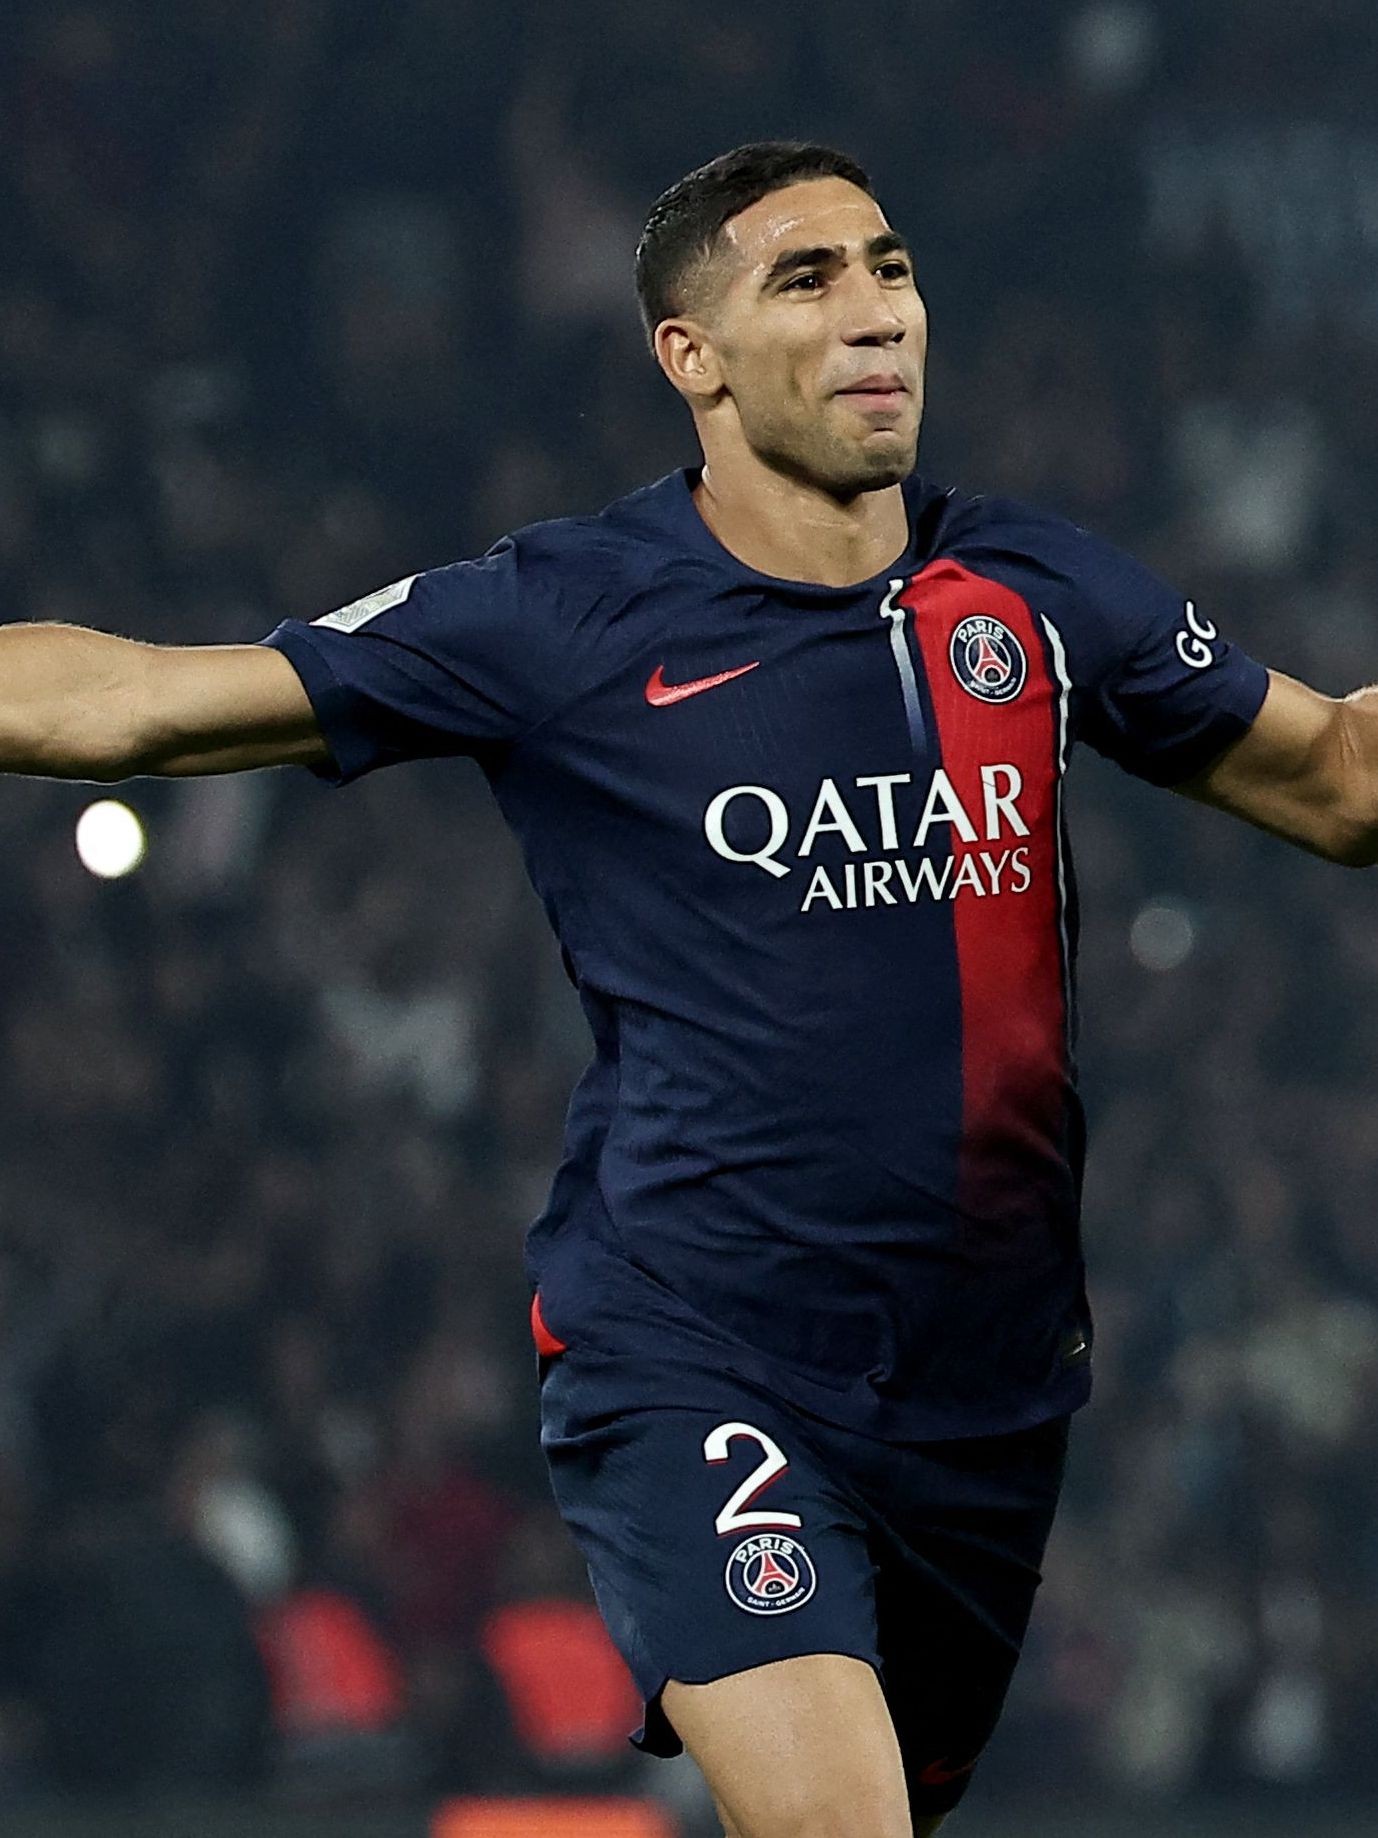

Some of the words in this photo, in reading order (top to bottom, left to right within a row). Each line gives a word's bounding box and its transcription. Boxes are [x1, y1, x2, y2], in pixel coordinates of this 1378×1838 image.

[957, 619, 1005, 643] PARIS
[704, 764, 1031, 878] QATAR
[800, 847, 1032, 912] AIRWAYS
[703, 1422, 802, 1537] 2
[735, 1537, 794, 1563] PARIS
